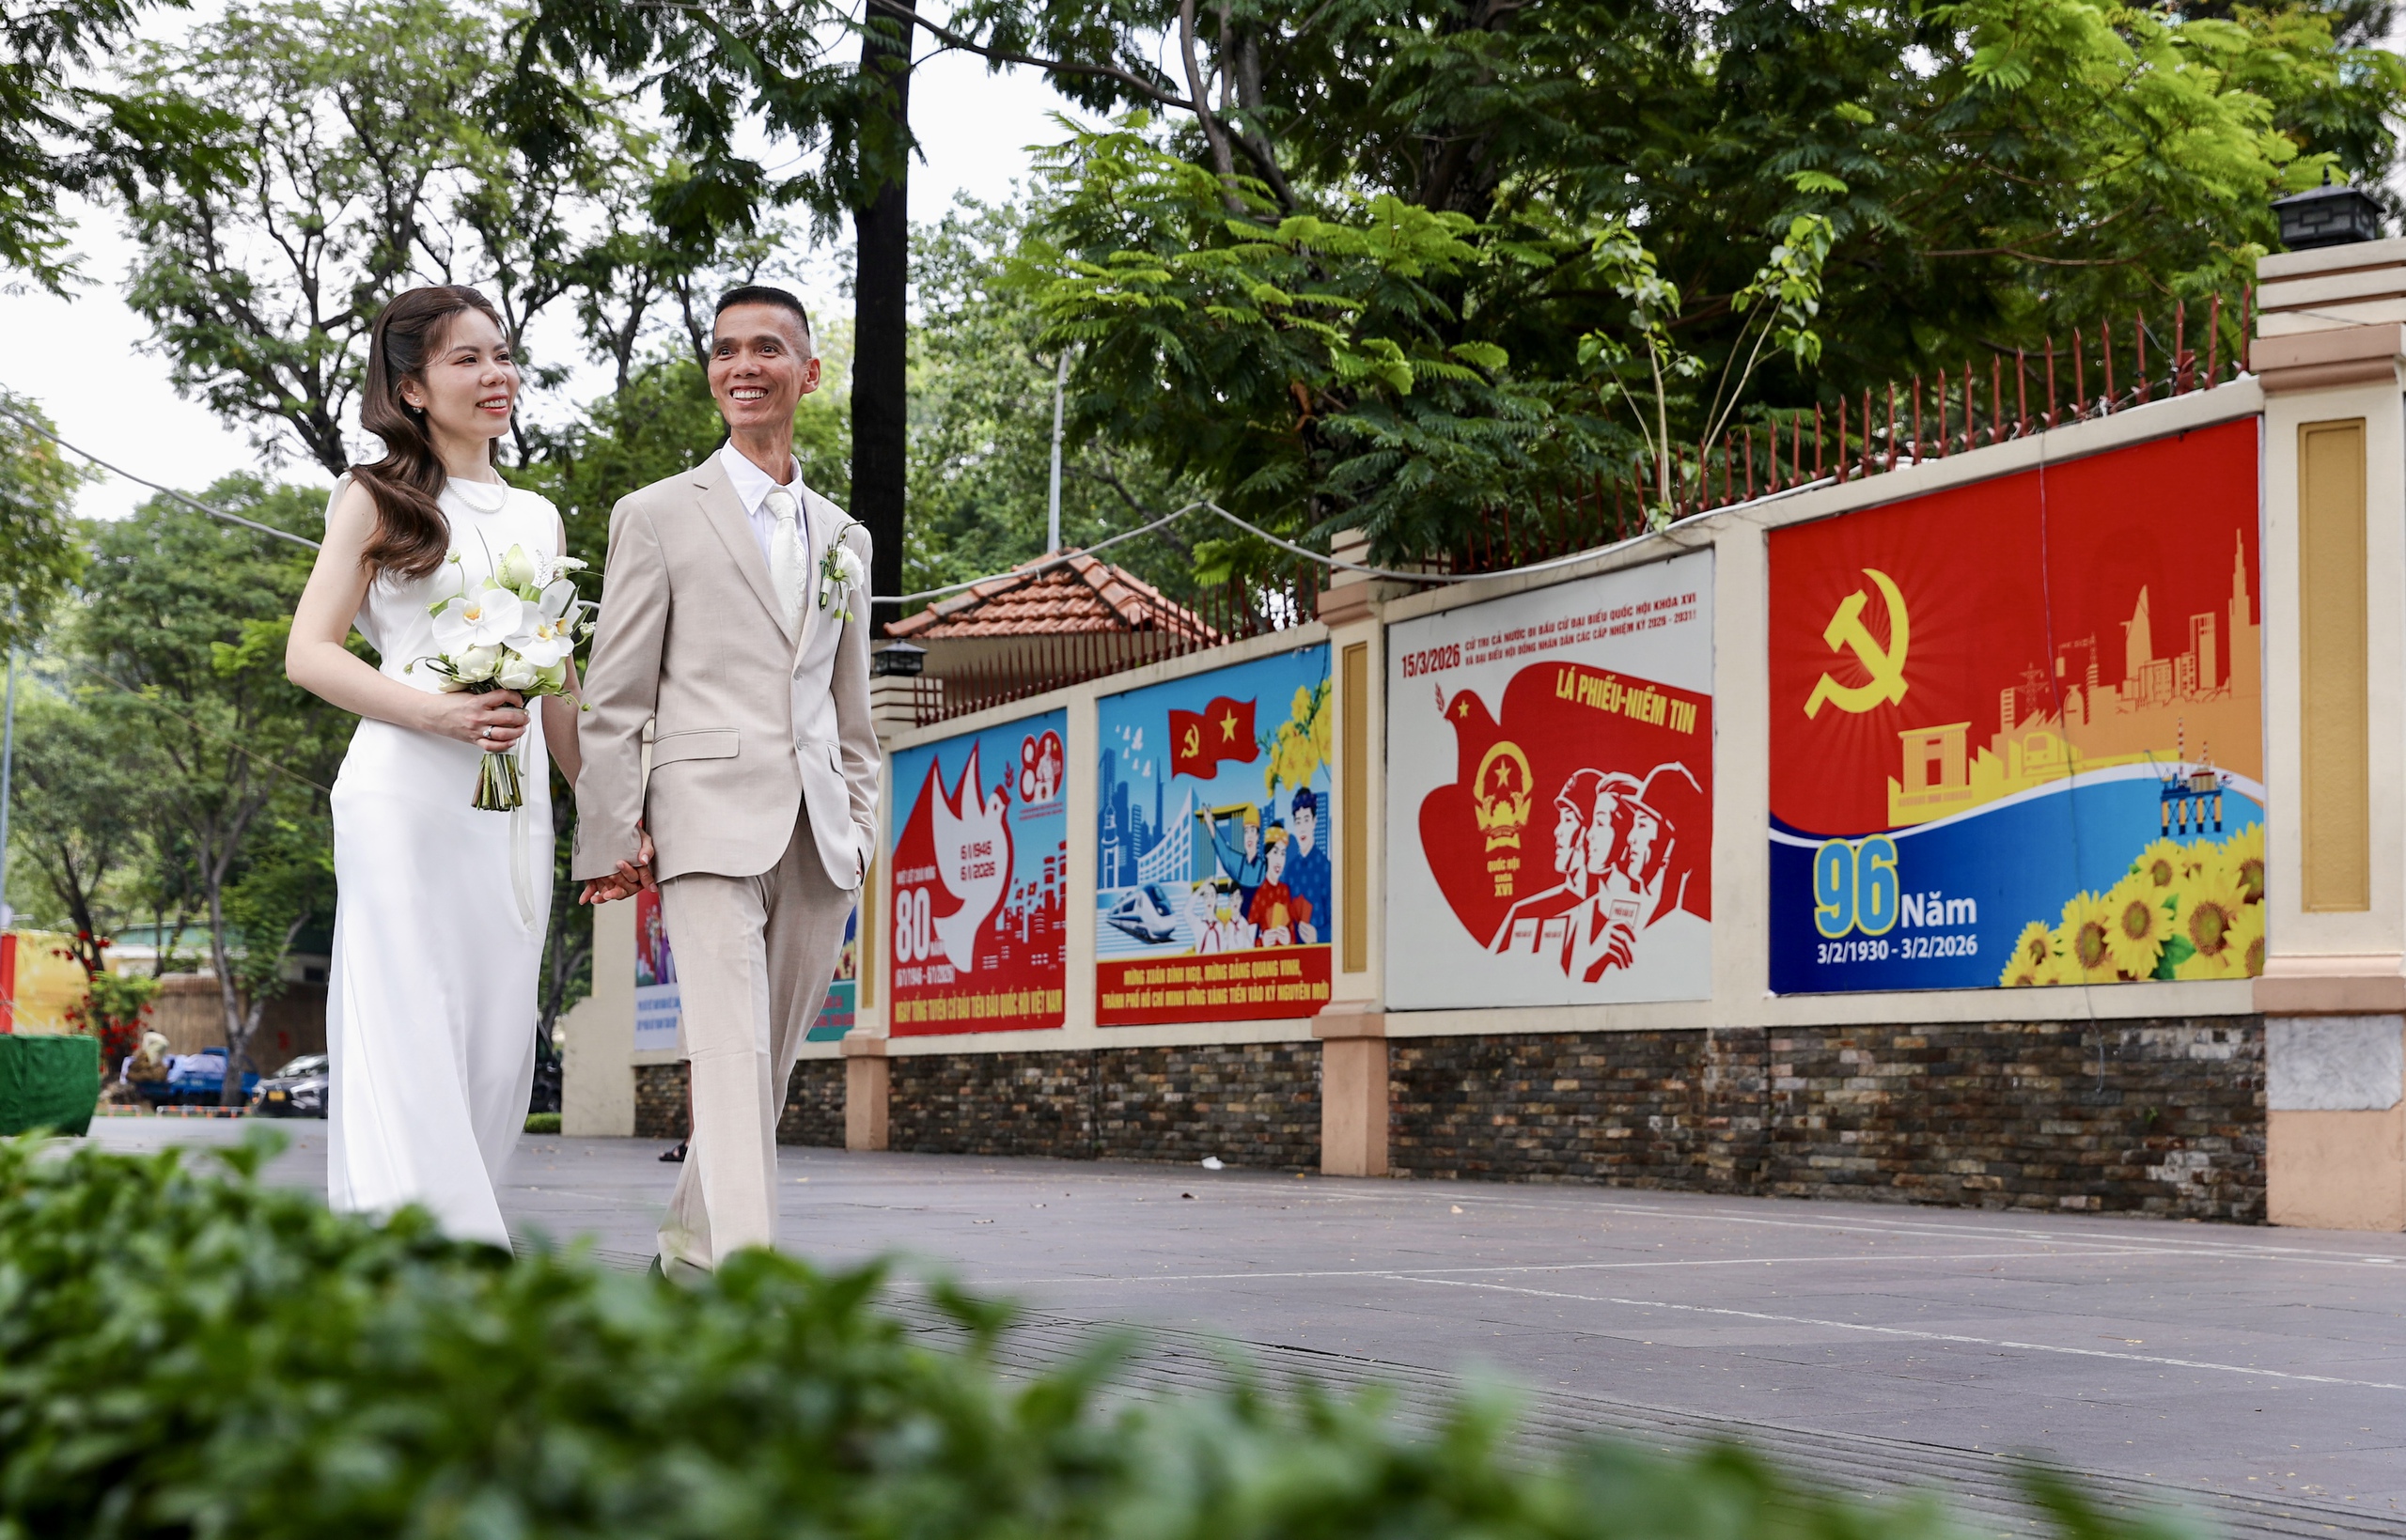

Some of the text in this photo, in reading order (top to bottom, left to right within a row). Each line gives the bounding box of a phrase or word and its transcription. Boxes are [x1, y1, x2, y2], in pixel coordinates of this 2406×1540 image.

[1609, 602, 1633, 620] QUỐC
[1635, 601, 1652, 615] HỘI
[1681, 592, 1697, 605] XVI
[1401, 643, 1461, 678] 15/3/2026
[1555, 665, 1576, 702] LÁ
[1669, 698, 1697, 736] TIN
[1813, 833, 1899, 940] 96
[896, 886, 930, 962] 80
[1900, 891, 1977, 928] Năm
[1817, 940, 1890, 965] 3/2/1930
[1899, 934, 1978, 960] 3/2/2026
[1251, 959, 1279, 980] QUANG
